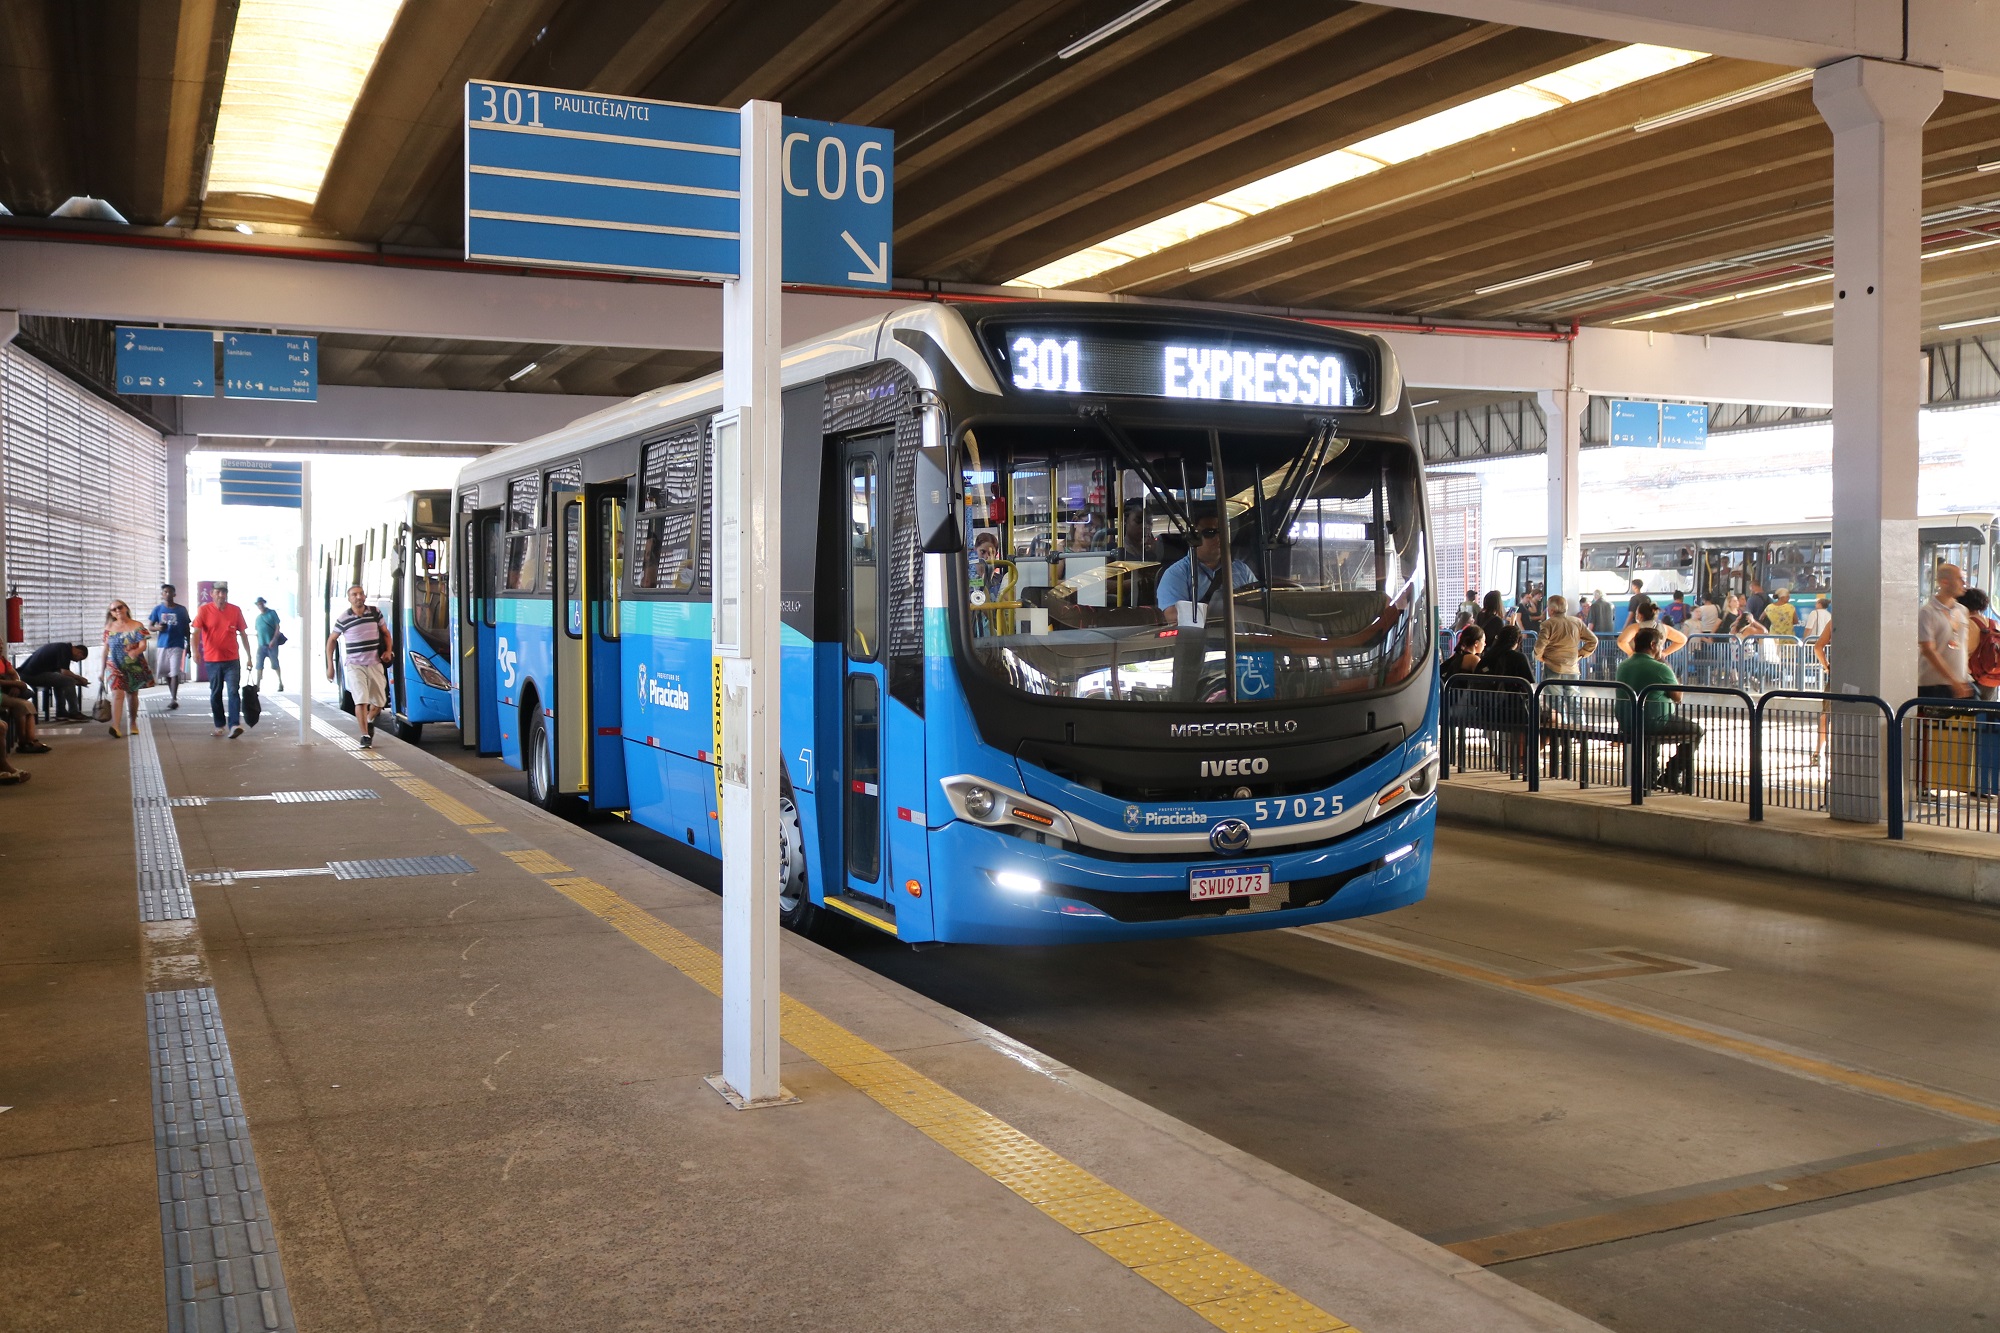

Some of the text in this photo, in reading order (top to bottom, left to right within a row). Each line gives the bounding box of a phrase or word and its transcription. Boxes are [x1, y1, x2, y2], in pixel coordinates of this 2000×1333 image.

[481, 86, 649, 127] 301 PAULICÉIA/TCI
[782, 132, 886, 204] C06
[303, 340, 310, 350] A
[303, 352, 309, 362] B
[1012, 336, 1342, 406] 301 EXPRESSA
[222, 459, 273, 469] Desembarque
[650, 679, 689, 710] Piracicaba
[1170, 719, 1298, 738] MASCARELLO
[1200, 757, 1269, 777] IVECO
[1145, 811, 1208, 825] Piracicaba
[1255, 795, 1344, 821] 57025
